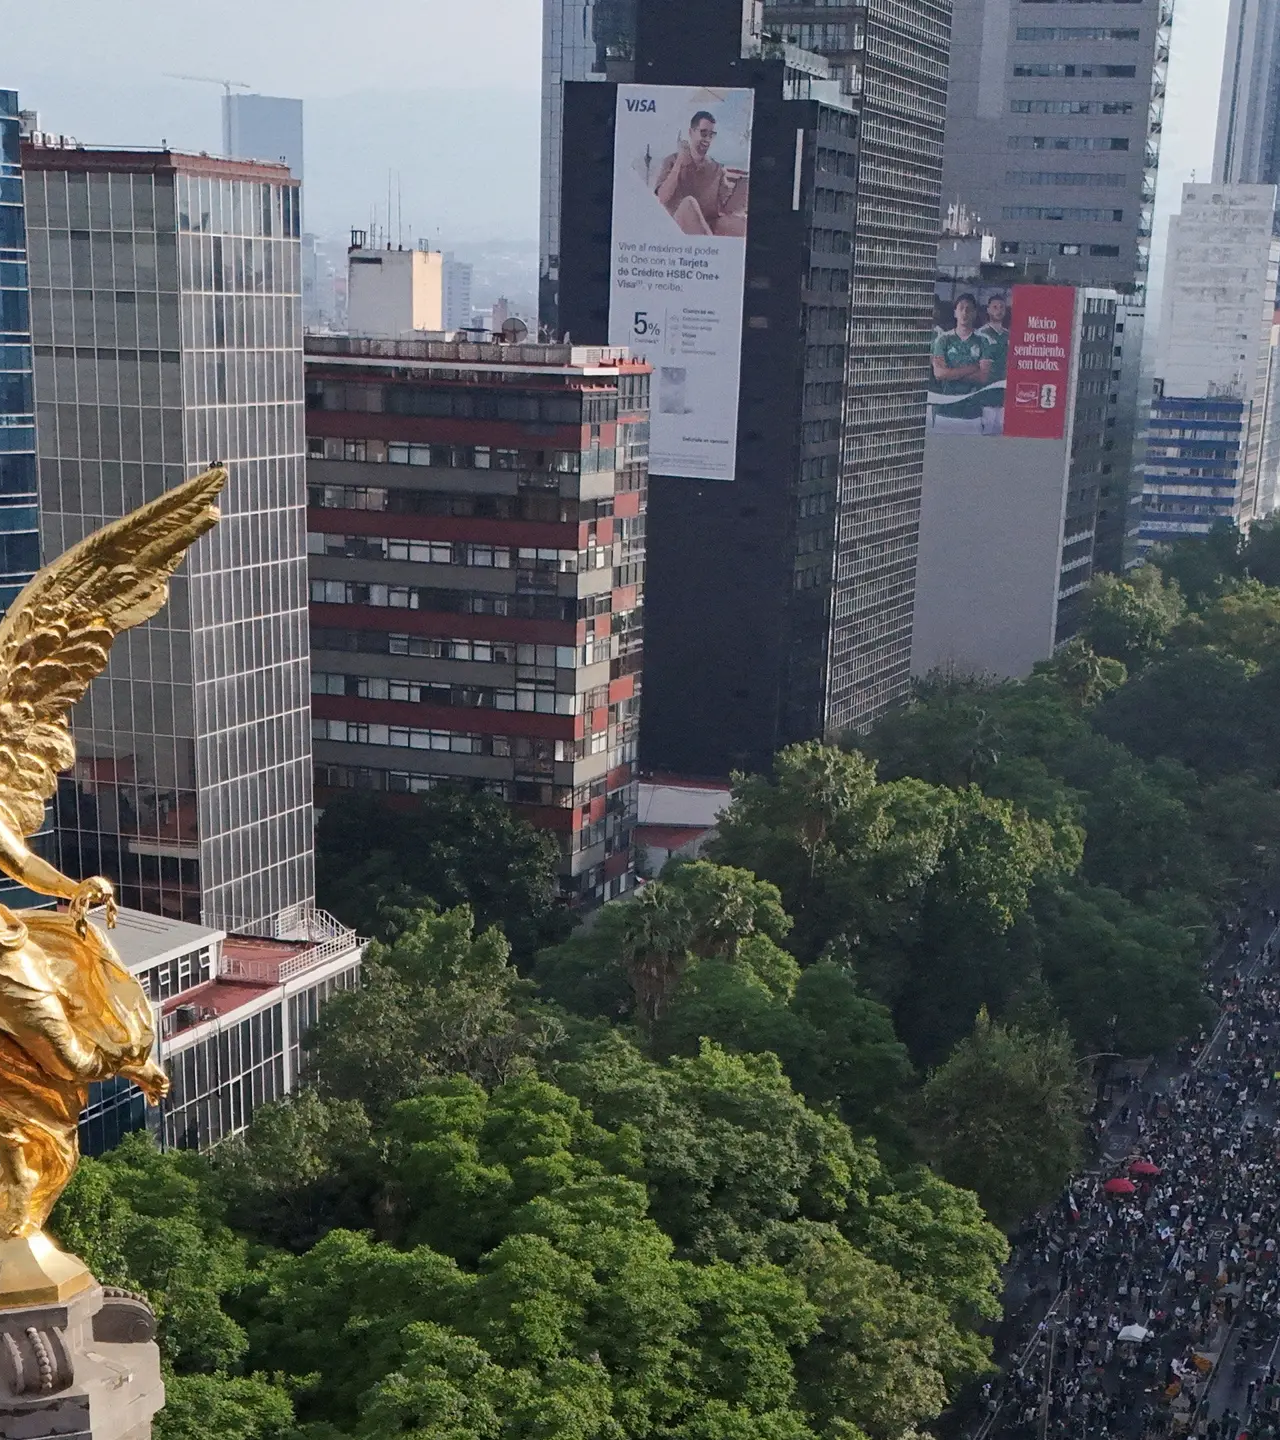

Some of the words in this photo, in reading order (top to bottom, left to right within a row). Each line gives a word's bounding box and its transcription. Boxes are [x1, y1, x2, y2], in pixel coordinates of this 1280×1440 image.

[625, 98, 657, 113] VISA
[619, 242, 636, 251] Vive
[695, 247, 719, 256] poder
[679, 258, 708, 268] Tarjeta
[617, 267, 629, 276] de
[666, 270, 693, 279] HSBC
[695, 271, 719, 280] One+
[1027, 316, 1057, 329] México
[1024, 332, 1035, 343] no
[1036, 333, 1045, 343] es
[1047, 333, 1058, 344] un
[1014, 344, 1065, 358] sentimiento,
[1018, 359, 1032, 370] son
[1034, 358, 1059, 371] todos.
